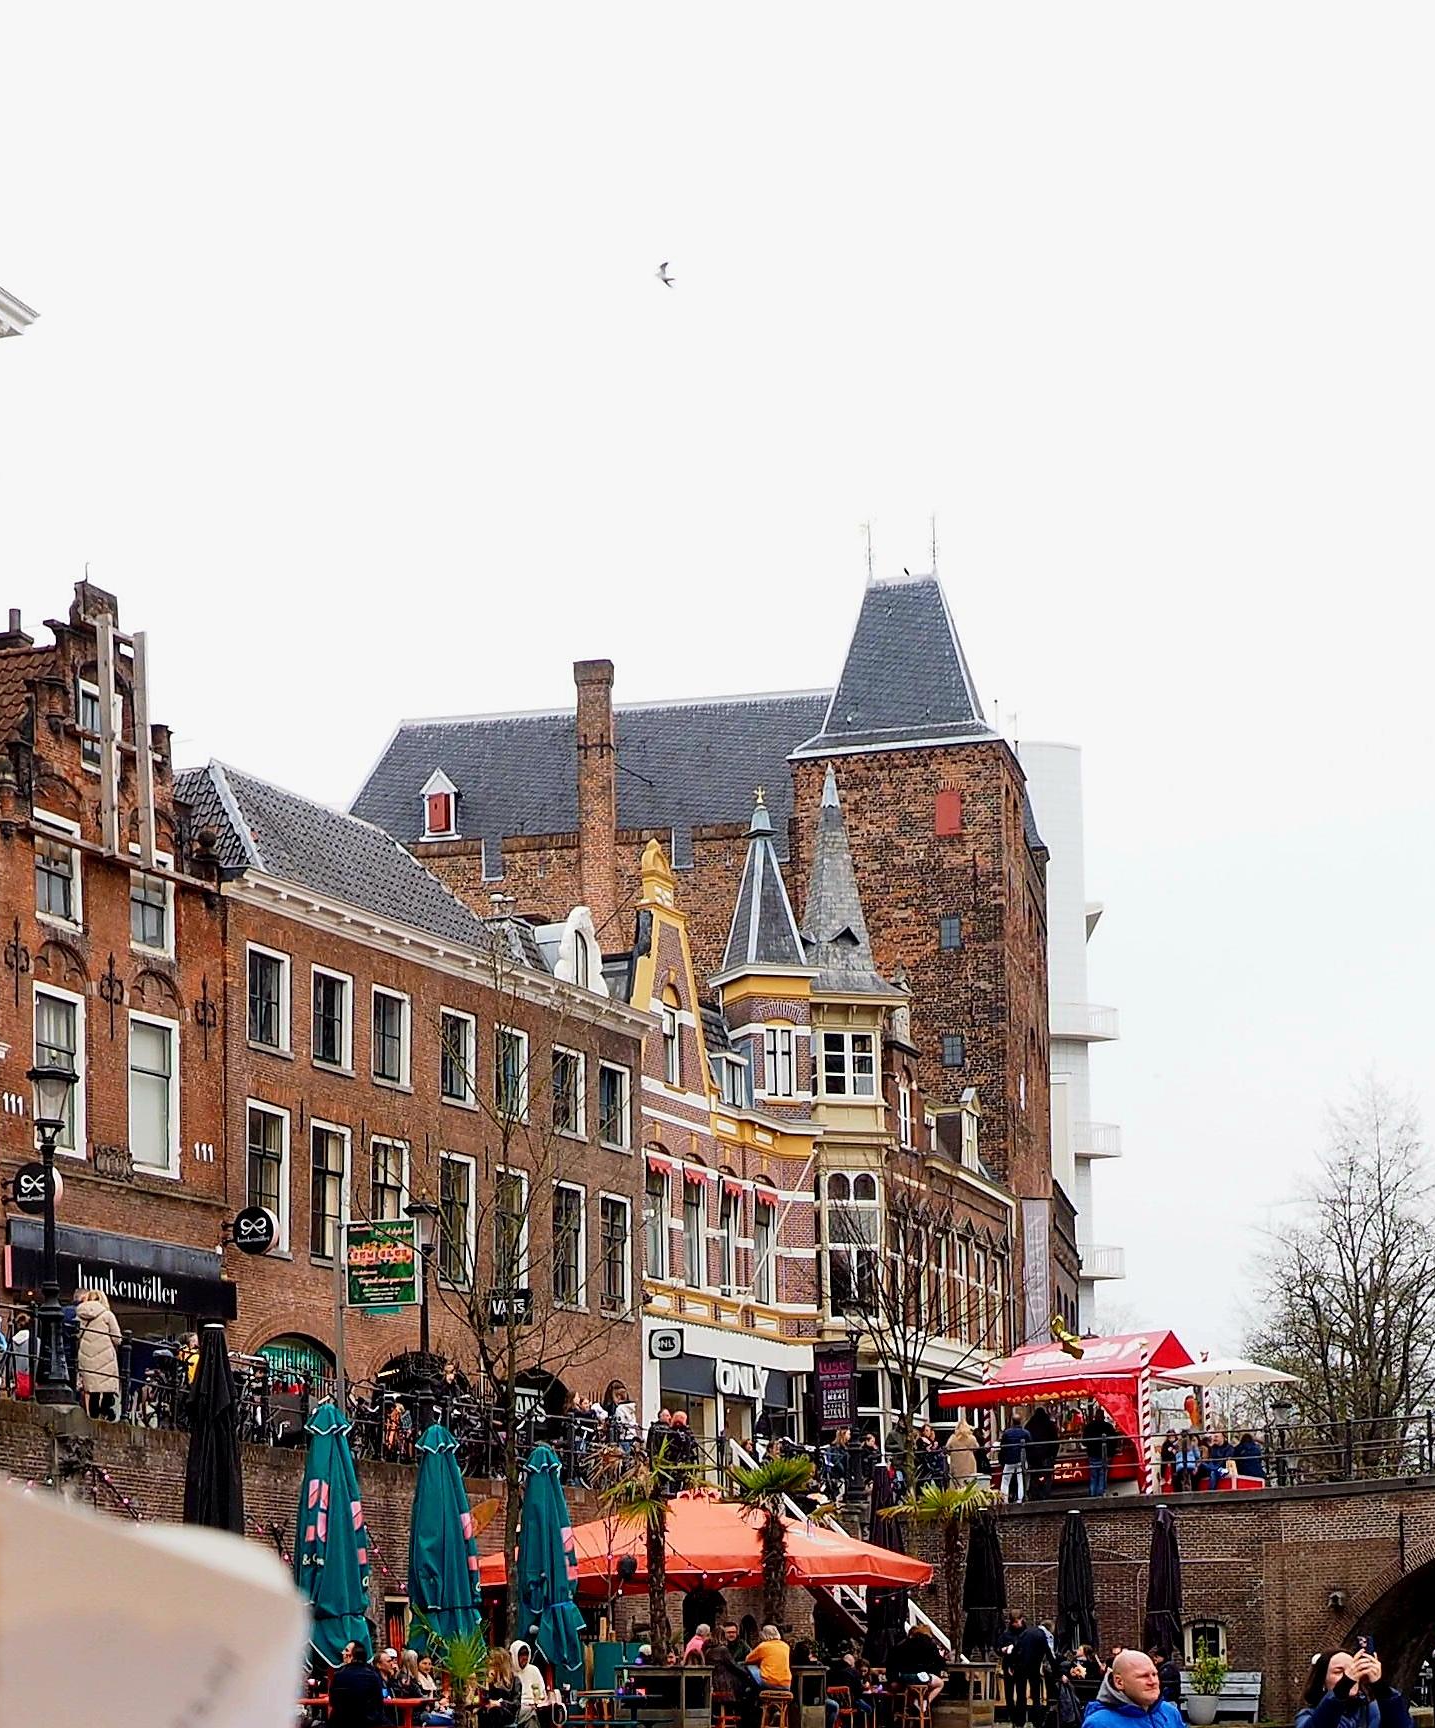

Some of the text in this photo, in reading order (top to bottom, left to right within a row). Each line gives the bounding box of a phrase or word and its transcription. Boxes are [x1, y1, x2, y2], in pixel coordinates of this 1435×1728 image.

[2, 1091, 24, 1116] 111
[193, 1141, 215, 1163] 111
[78, 1263, 178, 1305] hunkemöller
[716, 1359, 770, 1399] ONLY
